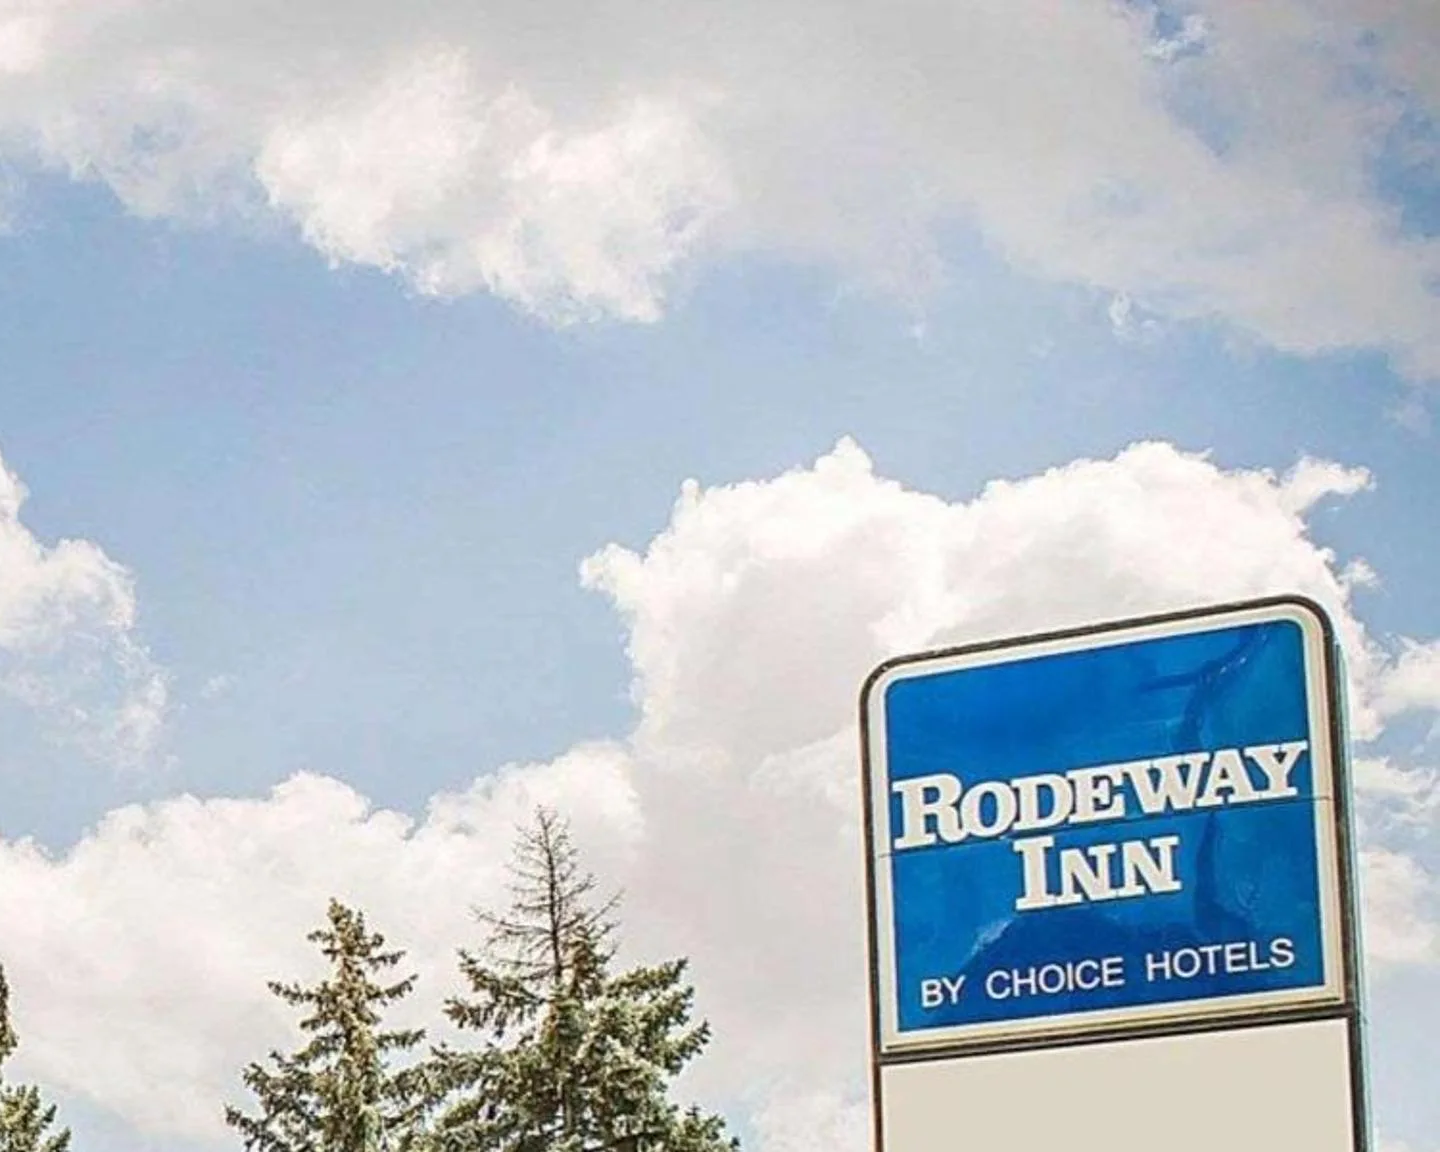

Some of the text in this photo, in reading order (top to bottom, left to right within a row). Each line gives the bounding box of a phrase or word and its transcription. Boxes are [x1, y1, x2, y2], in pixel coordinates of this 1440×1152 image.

[892, 741, 1308, 849] RODEWAY
[1013, 836, 1181, 911] INN
[921, 939, 1296, 1008] BY CHOICE HOTELS
